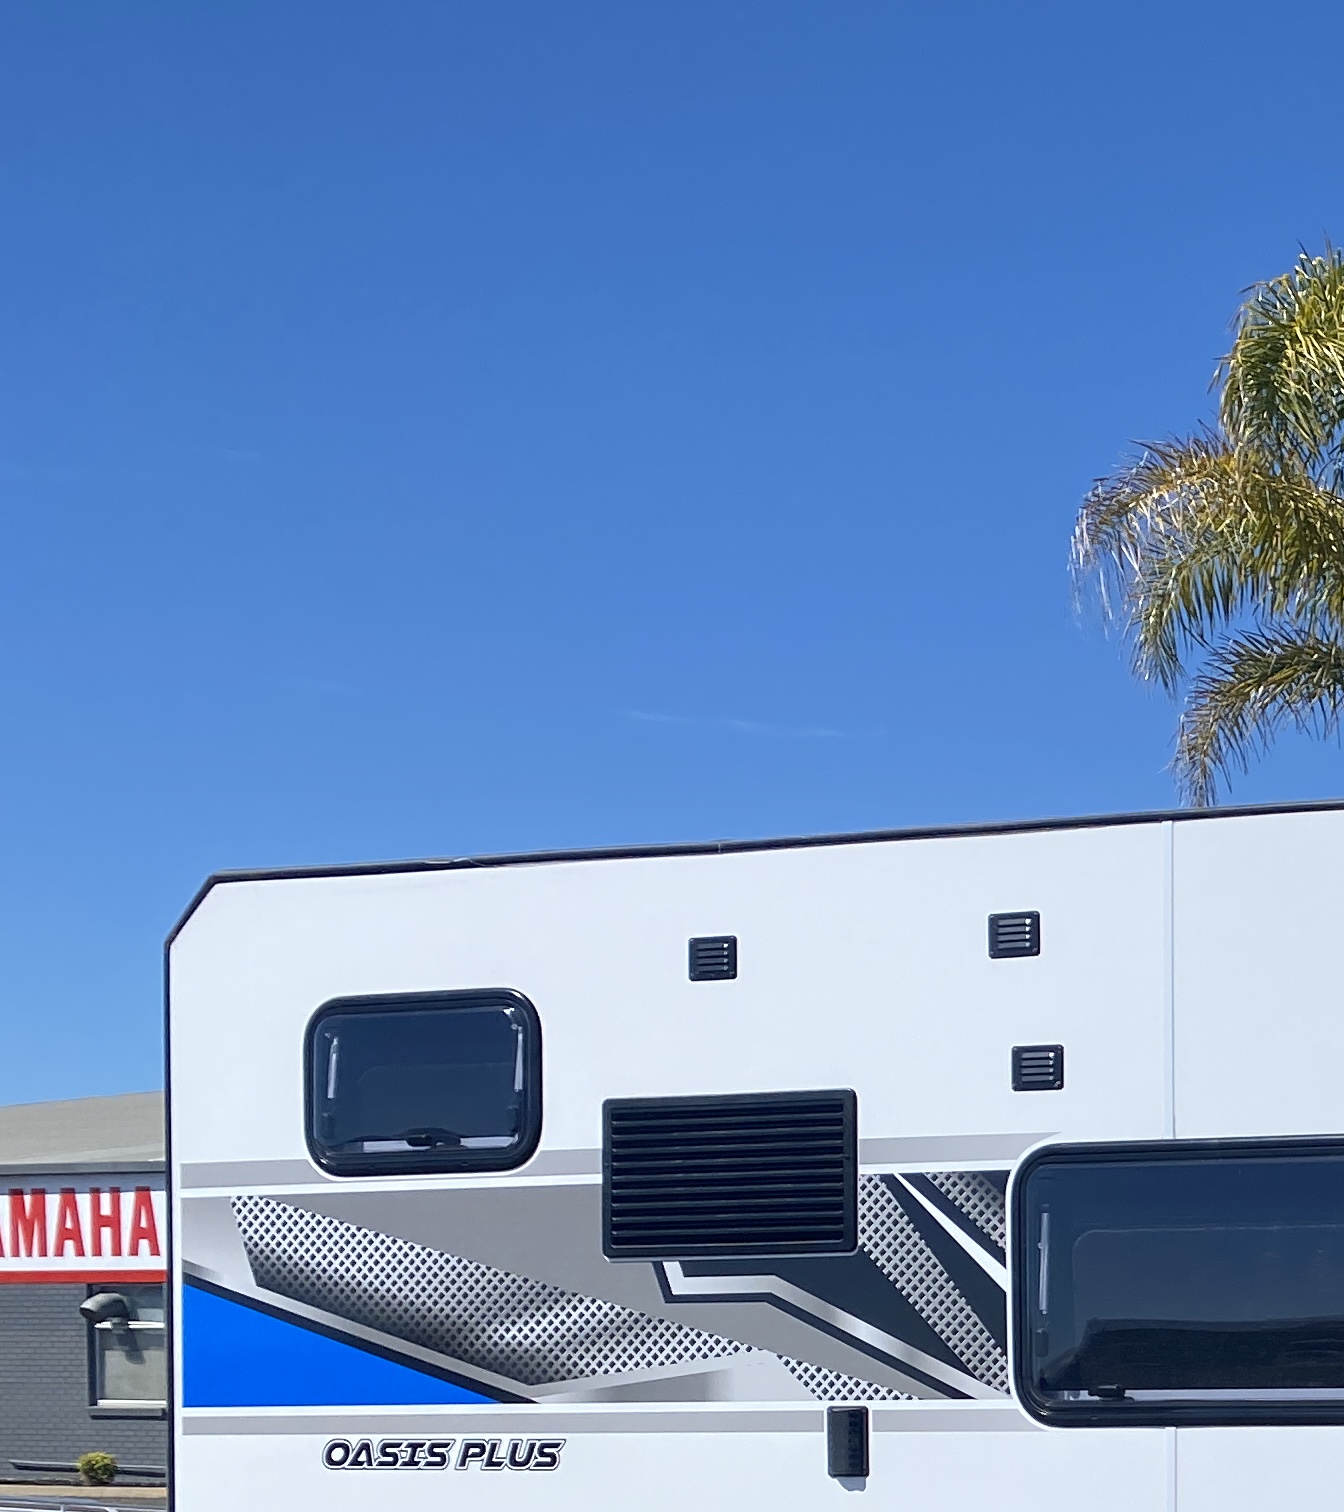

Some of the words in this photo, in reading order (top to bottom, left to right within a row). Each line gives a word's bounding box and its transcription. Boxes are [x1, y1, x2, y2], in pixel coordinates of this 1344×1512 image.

[0, 1186, 160, 1257] MAHA
[322, 1438, 456, 1470] OASIS
[455, 1438, 566, 1471] PLUS
